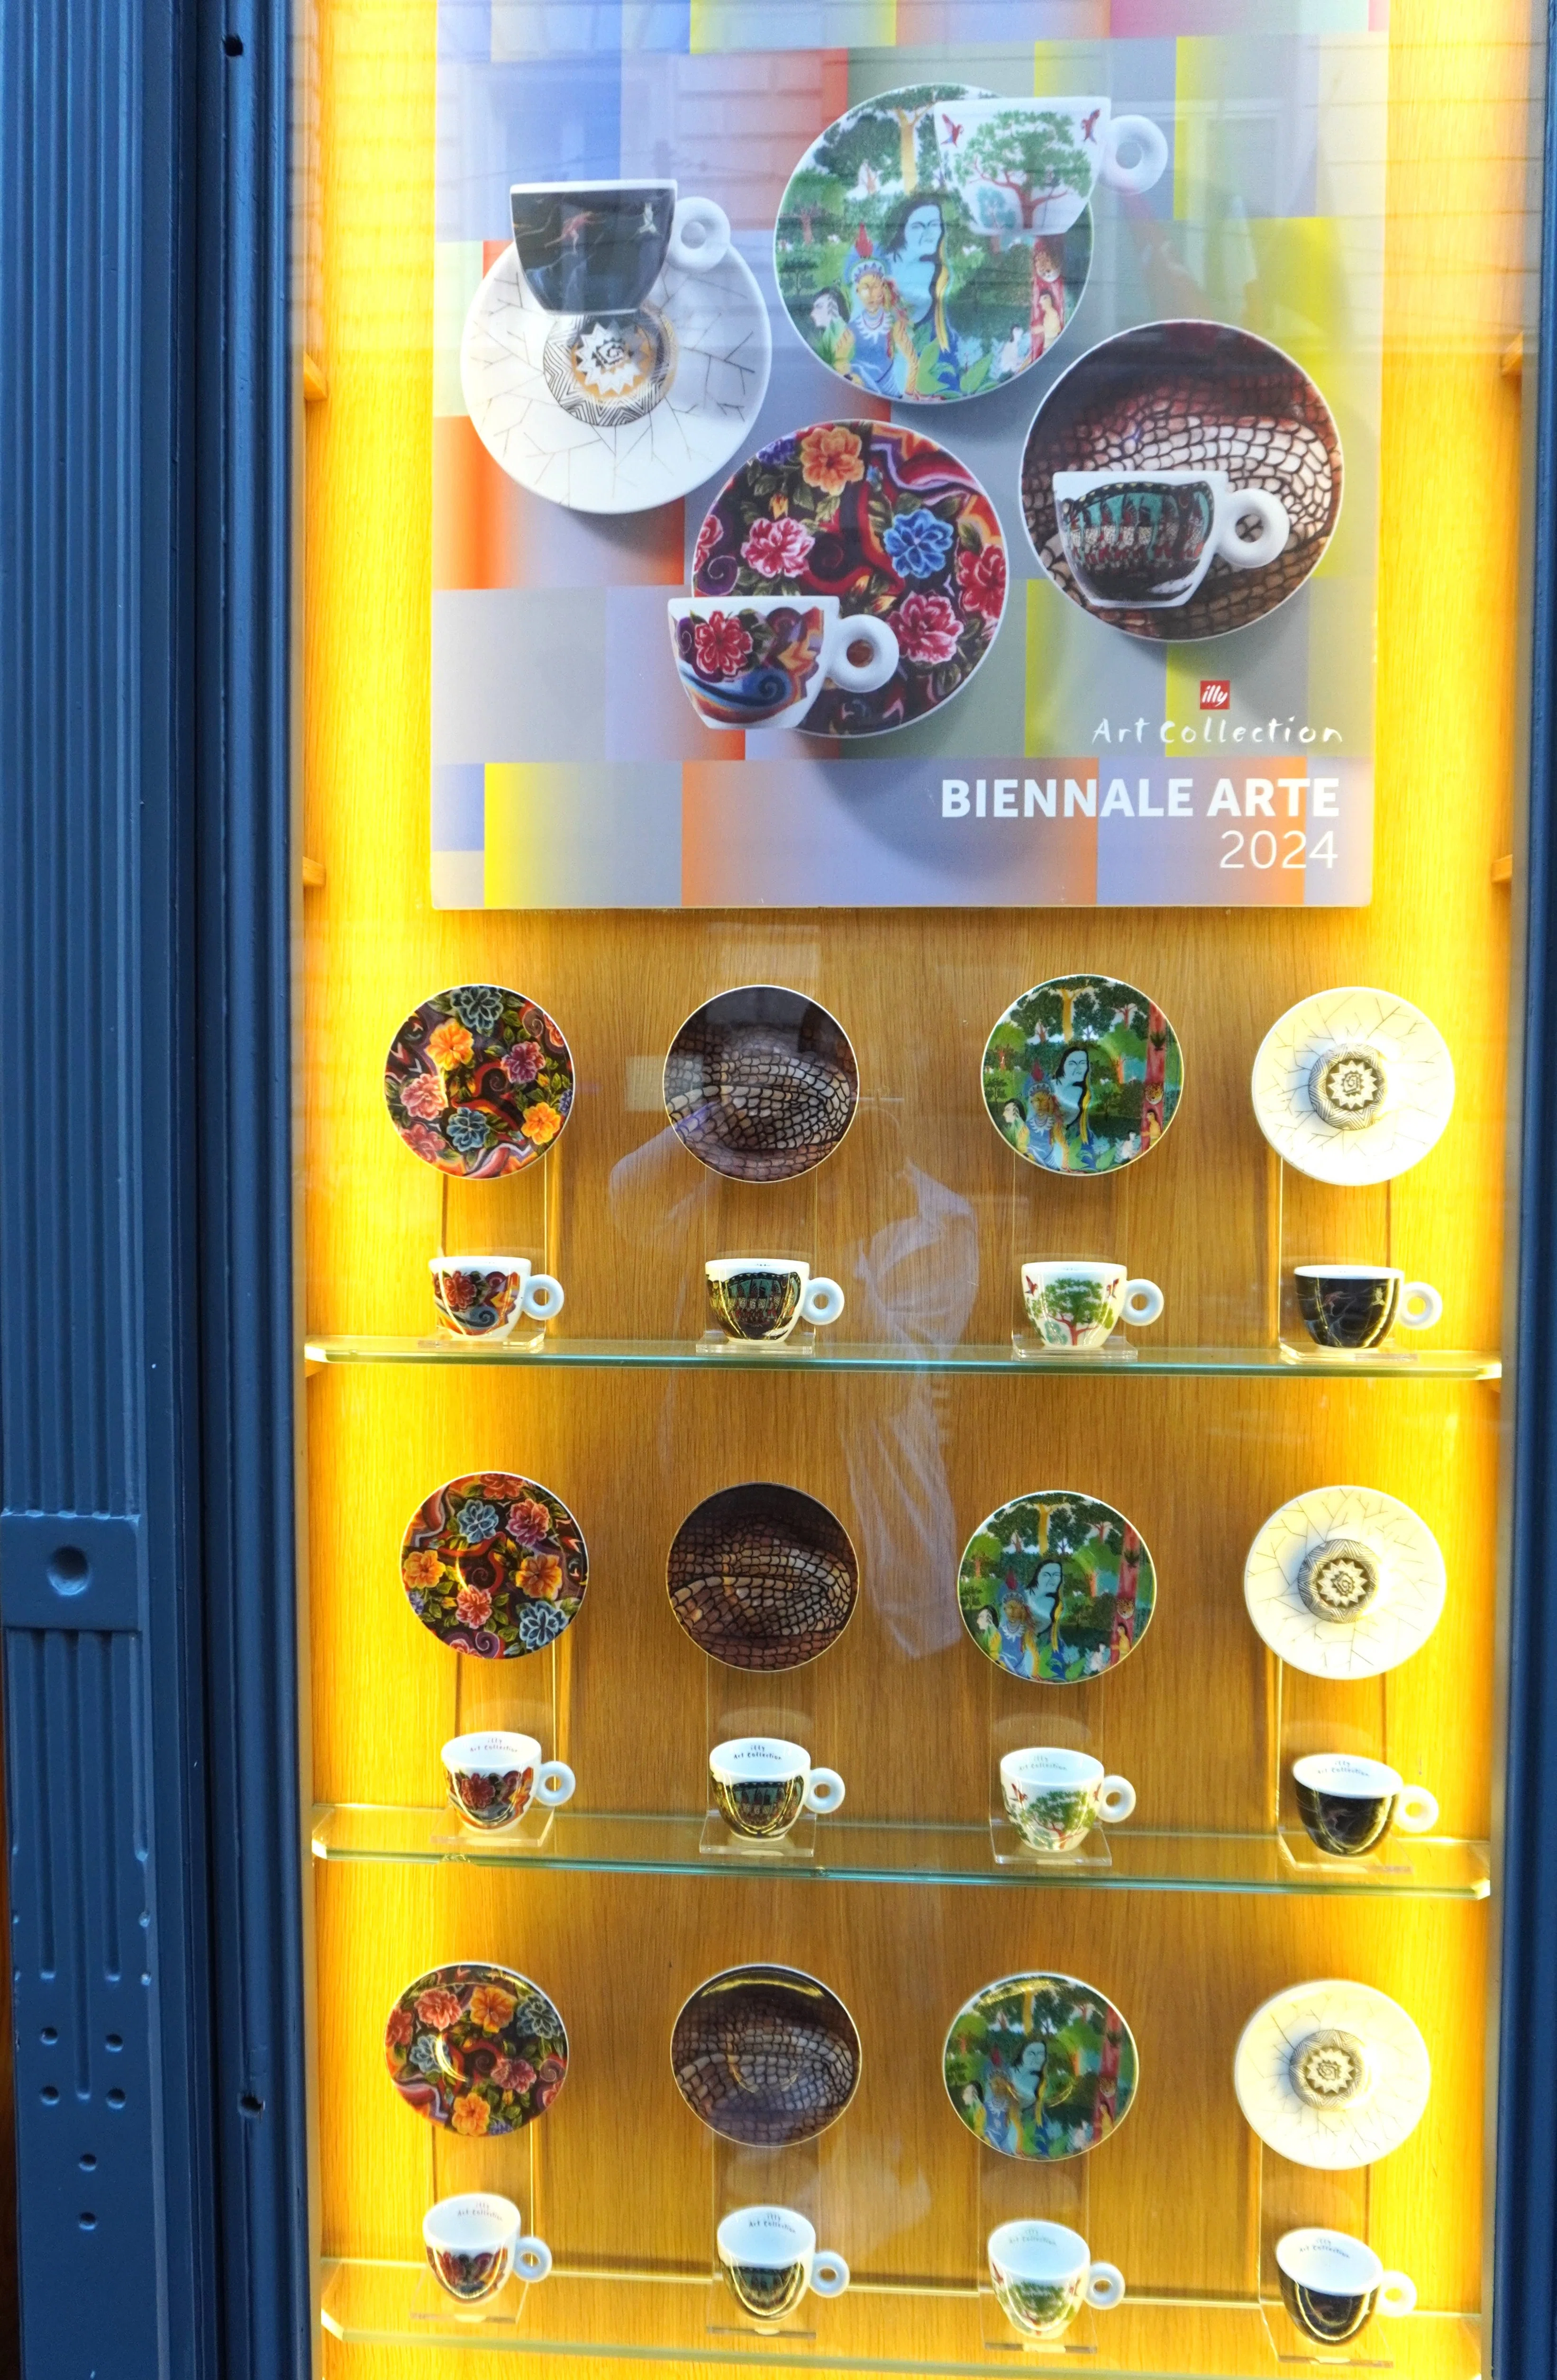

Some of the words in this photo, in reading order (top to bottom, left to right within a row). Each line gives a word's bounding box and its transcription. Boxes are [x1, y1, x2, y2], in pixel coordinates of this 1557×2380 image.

[1202, 683, 1229, 706] illy
[1092, 718, 1150, 744] Art
[1160, 716, 1343, 744] Collection
[941, 778, 1193, 818] BIENNALE
[1206, 778, 1340, 817] ARTE
[1219, 830, 1339, 869] 2024
